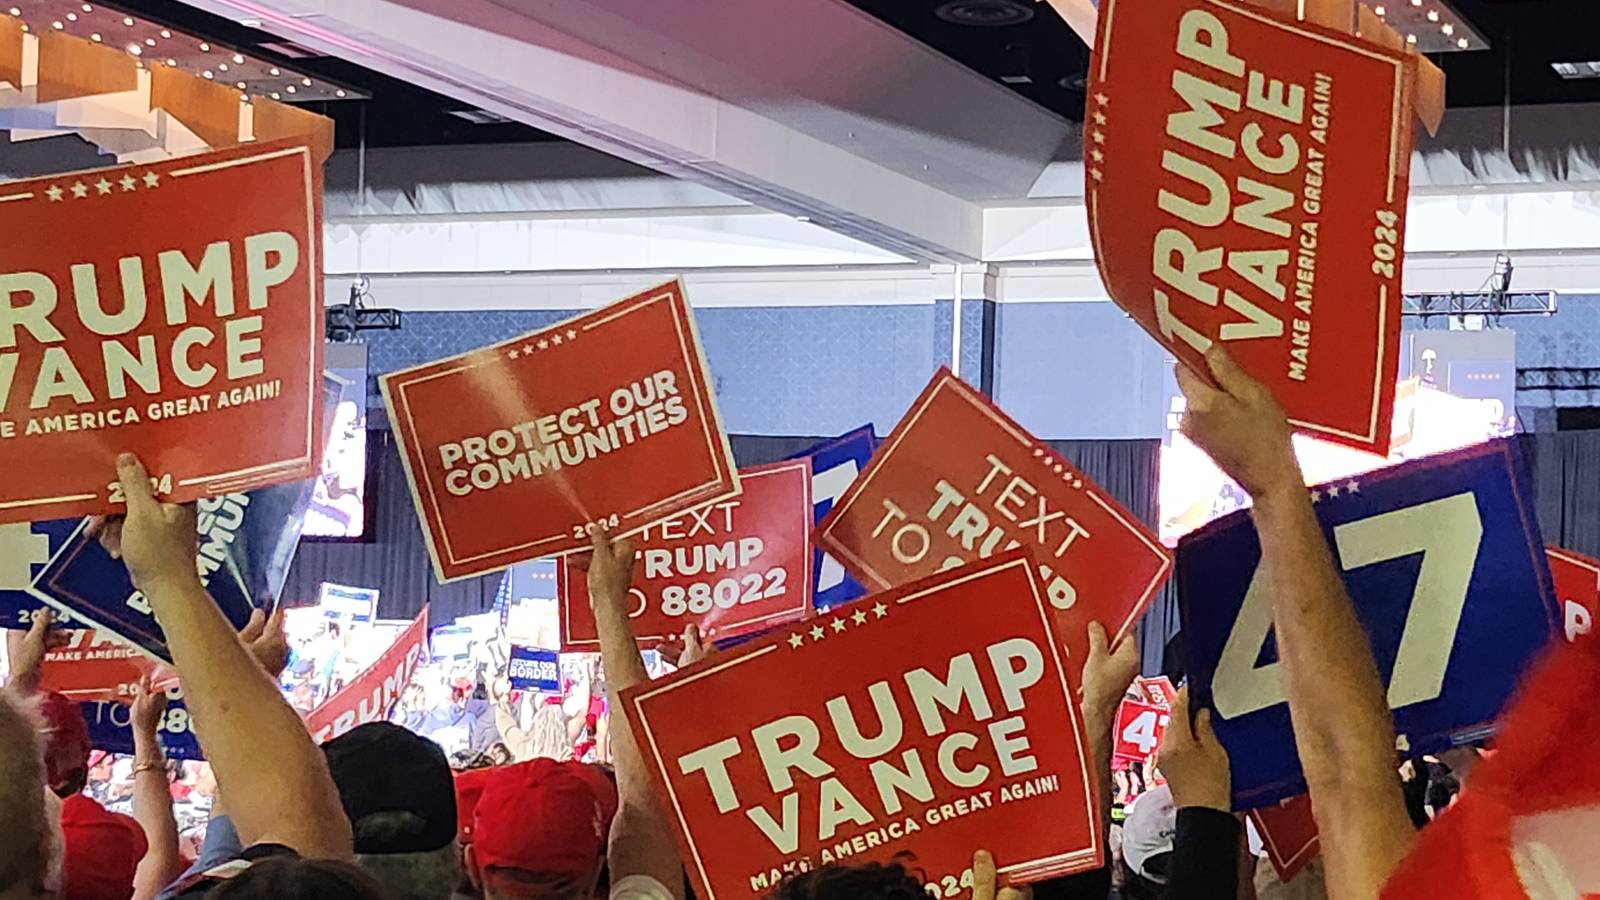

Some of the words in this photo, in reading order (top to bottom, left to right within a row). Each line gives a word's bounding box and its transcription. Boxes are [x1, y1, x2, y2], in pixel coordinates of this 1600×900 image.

[1312, 72, 1333, 144] AGAIN!
[1153, 9, 1246, 355] TRUMP
[1219, 70, 1305, 341] VANCE
[1303, 147, 1326, 216] GREAT
[1296, 221, 1319, 314] AMERICA
[1371, 209, 1399, 280] 2024
[0, 231, 299, 350] RUMP
[1288, 315, 1312, 381] MAKE
[25, 406, 140, 435] AMERICA
[147, 396, 210, 420] GREAT
[216, 379, 281, 409] AGAIN!
[439, 400, 601, 470] PROTECT
[610, 369, 678, 417] OUR
[445, 396, 687, 497] COMMUNITIES
[107, 474, 173, 503] 24
[976, 454, 1090, 558] TEXT
[635, 537, 764, 579] RUMP
[872, 499, 930, 564] TO
[927, 479, 1077, 610] TRUP
[18, 609, 71, 623] 204
[661, 567, 787, 616] 88022
[45, 653, 82, 662] MAKE
[117, 683, 138, 696] 20
[509, 666, 557, 681] BORDER
[678, 638, 1044, 814] TRUMP
[1123, 711, 1169, 753] 4
[746, 716, 1038, 855] VANCE
[821, 818, 921, 866] AMERICA
[925, 790, 993, 825] GREAT
[1000, 775, 1059, 804] AGAIN!
[924, 868, 974, 900] 024
